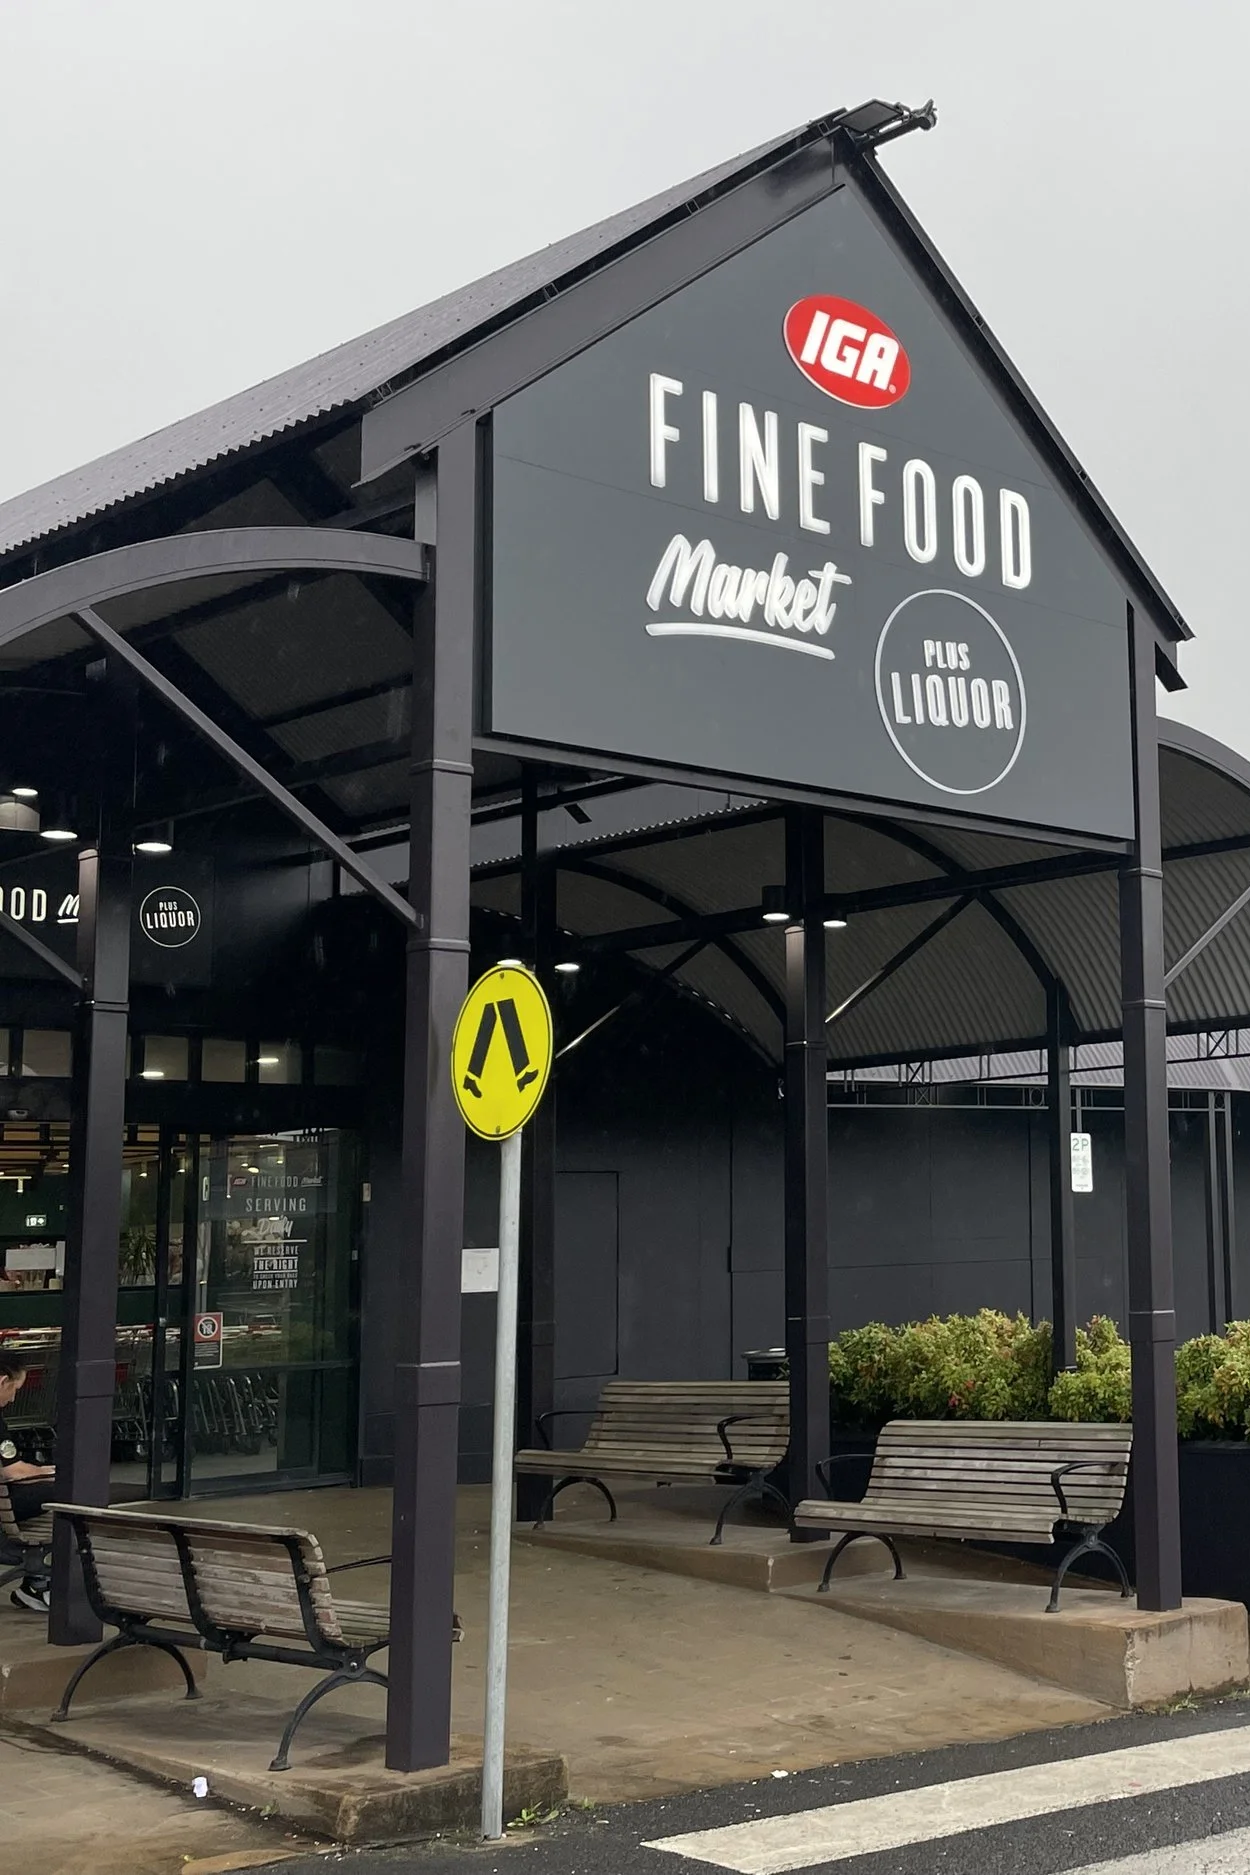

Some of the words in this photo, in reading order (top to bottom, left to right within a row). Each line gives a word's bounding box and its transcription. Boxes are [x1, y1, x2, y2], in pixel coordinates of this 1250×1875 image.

[799, 309, 899, 390] IGA
[649, 372, 831, 535] FINE
[858, 441, 1032, 590] FOOD
[646, 533, 852, 636] Market
[923, 639, 971, 670] PLUS
[890, 672, 1014, 730] LIQUOR
[159, 901, 178, 911] PLUS
[146, 910, 195, 929] LIQUOR
[1071, 1137, 1089, 1152] 2P
[251, 1175, 272, 1188] FINE
[275, 1175, 299, 1188] FOOD
[245, 1197, 306, 1212] SERVING
[267, 1245, 299, 1256] RESERVE
[254, 1260, 269, 1271] THE
[273, 1259, 298, 1270] RIGHT
[253, 1280, 272, 1290] UPON
[275, 1279, 298, 1289] ENTRY
